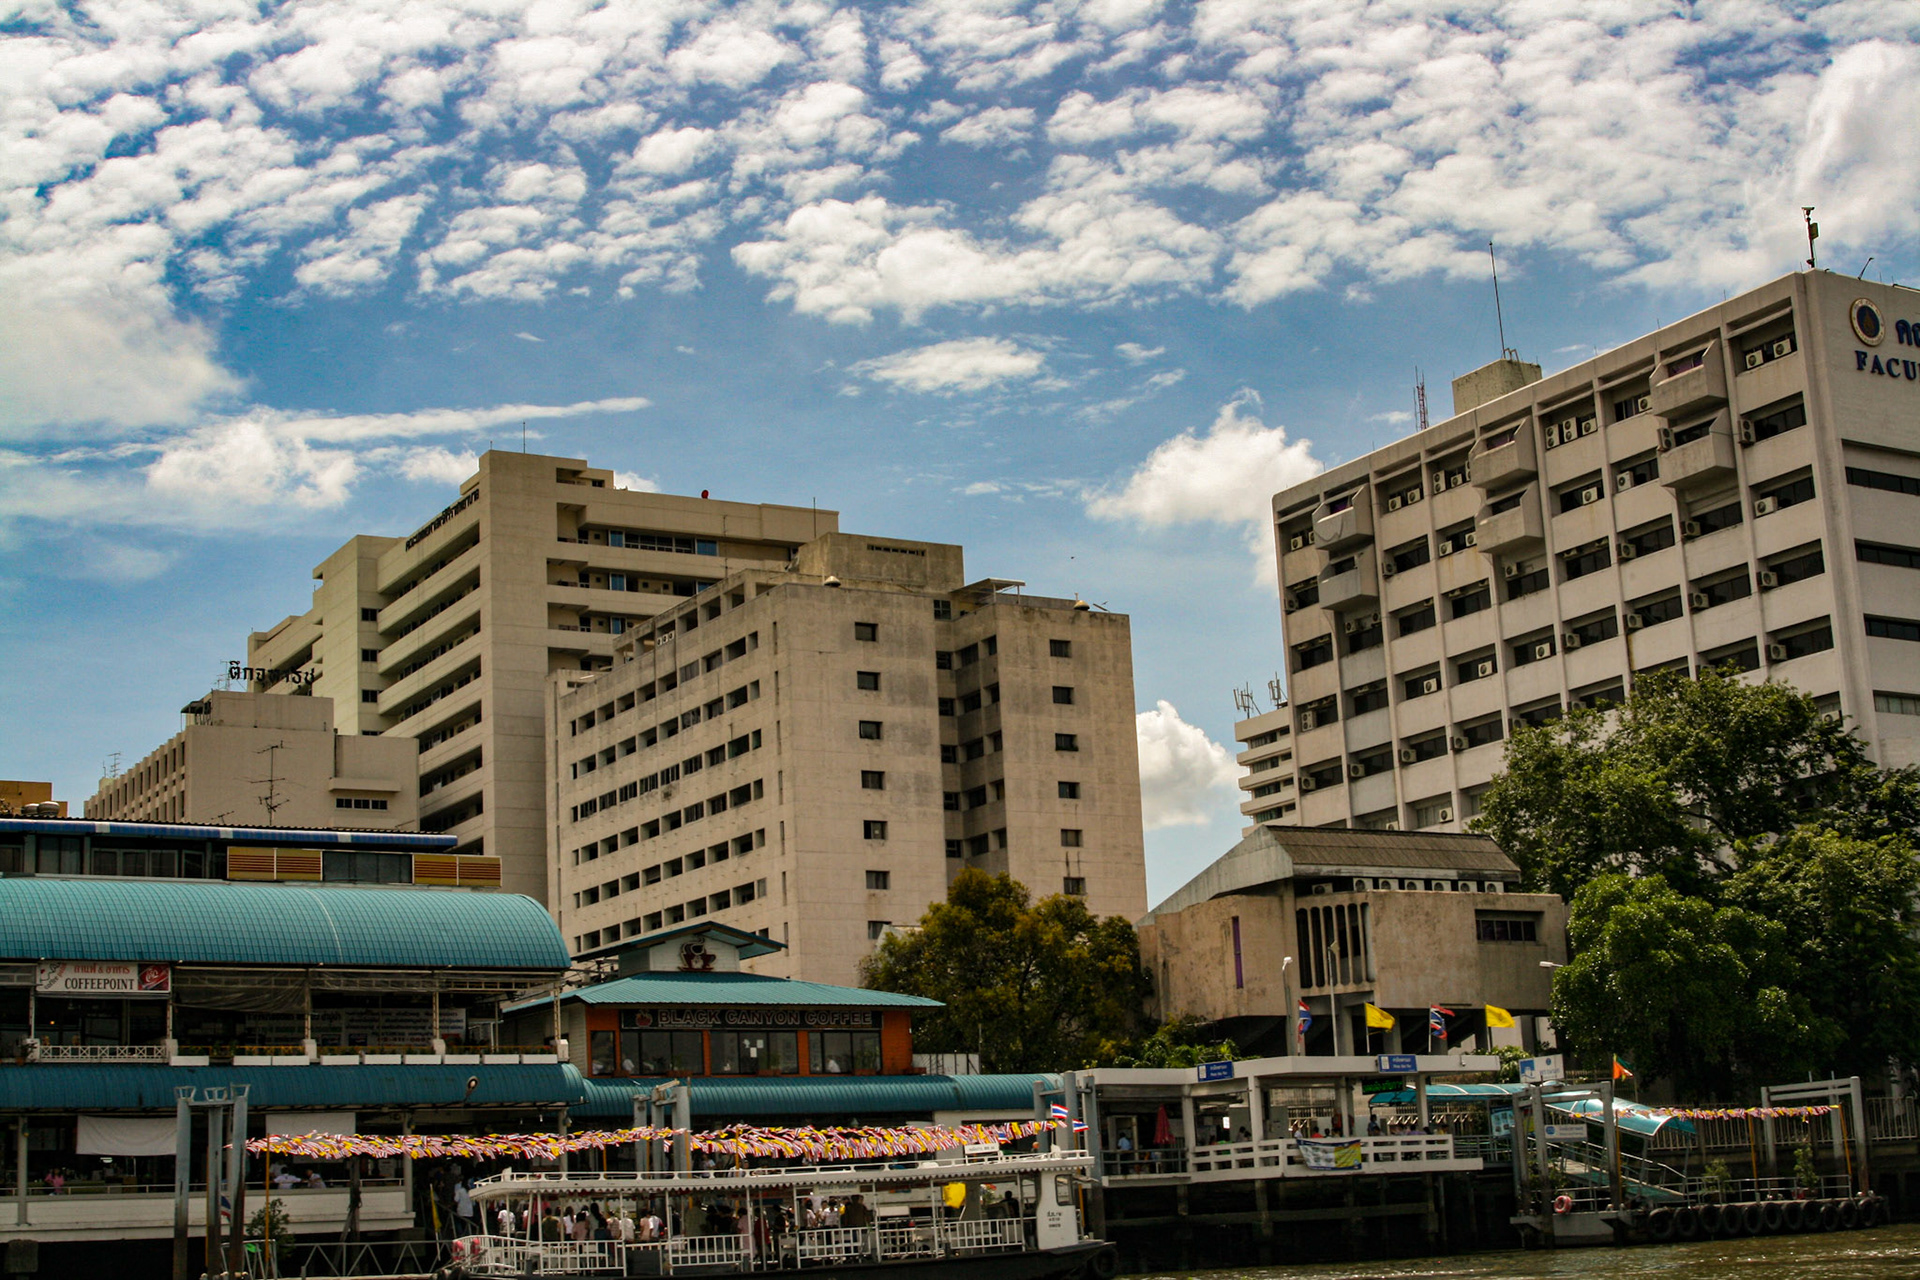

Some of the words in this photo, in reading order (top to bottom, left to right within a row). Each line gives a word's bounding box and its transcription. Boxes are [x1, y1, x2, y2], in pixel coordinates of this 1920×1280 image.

[1855, 350, 1920, 380] FACU
[64, 977, 135, 990] COFFEEPOINT
[658, 1009, 721, 1024] BLACK
[725, 1010, 800, 1025] CANYON
[804, 1010, 873, 1025] COFFEE
